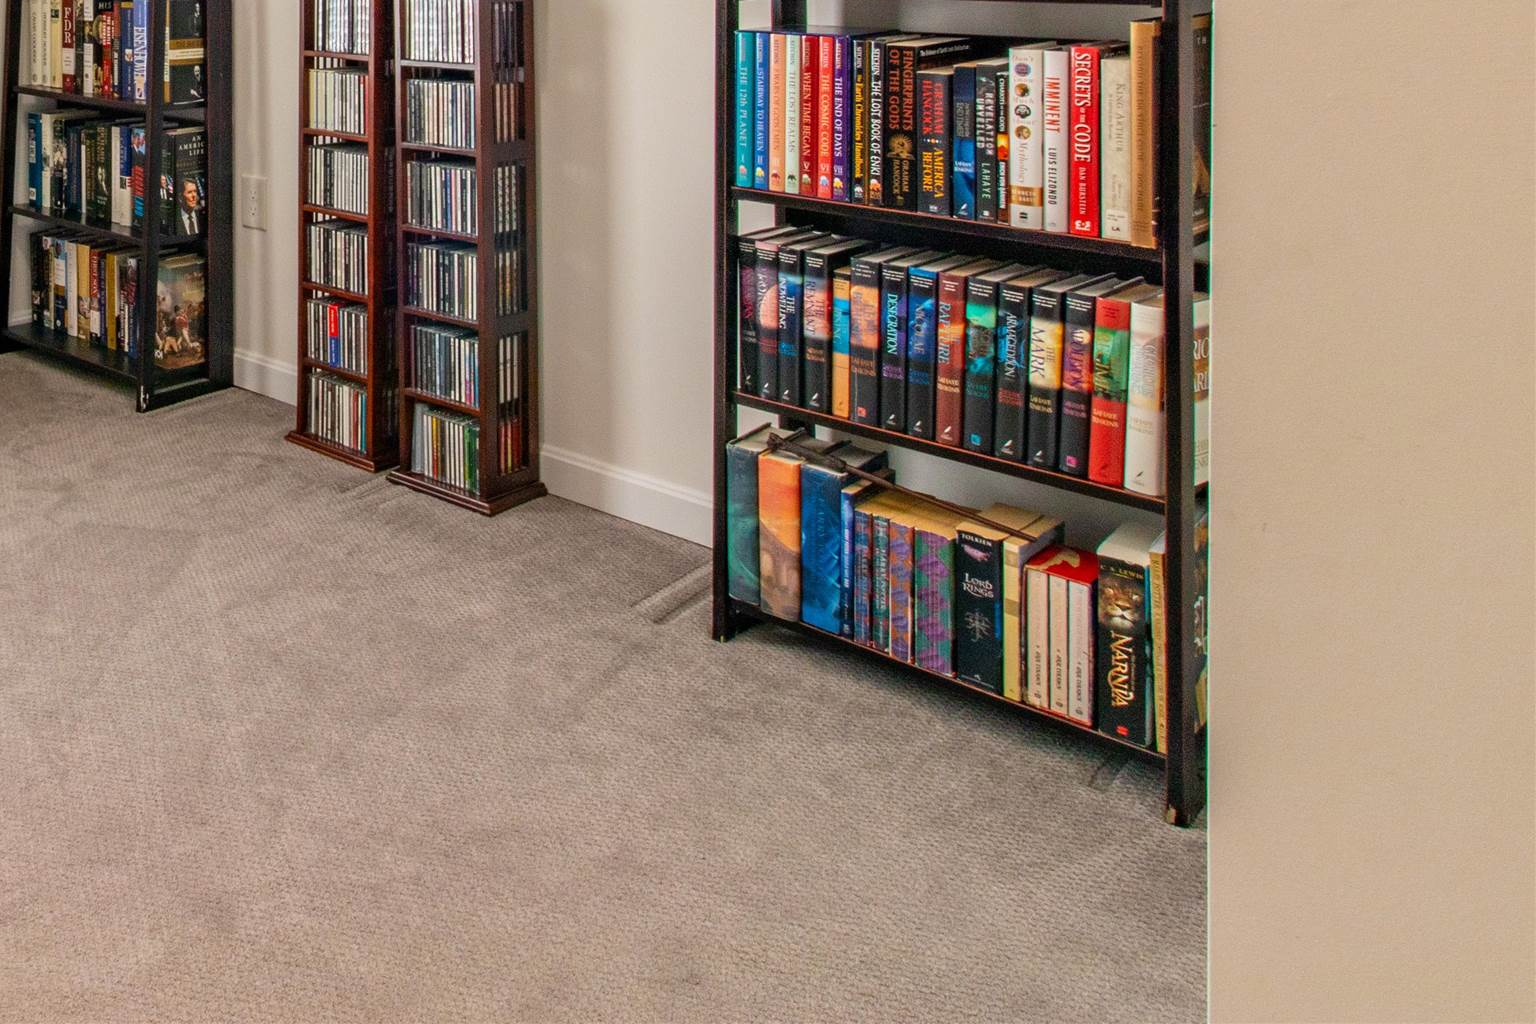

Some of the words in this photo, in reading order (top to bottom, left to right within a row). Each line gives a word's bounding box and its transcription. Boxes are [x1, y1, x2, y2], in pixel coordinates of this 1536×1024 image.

[64, 6, 72, 44] FDR
[134, 26, 146, 84] EISENHOWE
[872, 48, 880, 75] SITCHIN
[889, 49, 900, 68] OF
[740, 66, 748, 85] THE
[803, 72, 811, 100] WHEN
[821, 74, 830, 91] THE
[834, 77, 843, 95] THE
[872, 80, 882, 96] THE
[889, 70, 900, 92] THE
[1074, 52, 1092, 106] SECRETS
[740, 88, 748, 106] 12th
[903, 50, 913, 131] FINGERPRINTS
[1045, 77, 1060, 133] IMMINENT
[1114, 83, 1126, 109] KING
[803, 102, 811, 124] TIME
[821, 94, 830, 127] COSMIC
[834, 98, 843, 120] END
[871, 98, 882, 116] LOST
[888, 96, 900, 130] GODS
[922, 80, 933, 134] HANCOCK
[934, 83, 944, 134] GRAHAM
[740, 109, 748, 147] PLANET
[834, 122, 843, 135] OF
[871, 119, 882, 144] BOOK
[976, 98, 985, 149] UNVEILED
[984, 92, 995, 156] REVELATION
[1114, 113, 1125, 152] ARTHUR
[178, 142, 204, 151] AMERIC
[803, 125, 811, 156] BEGAN
[821, 132, 830, 157] CODE
[834, 136, 843, 157] DAYS
[871, 146, 881, 155] OF
[1074, 124, 1092, 162] CODE
[870, 156, 882, 176] ENKI
[1048, 147, 1056, 165] LUIS
[922, 151, 932, 193] BEFORE
[934, 148, 944, 198] AMERICA
[981, 163, 991, 199] LAHAYE
[1048, 168, 1057, 205] ELIZONDO
[1079, 167, 1087, 180] DAN
[1079, 183, 1087, 215] BURSTEIN
[778, 276, 787, 330] INDWELLING
[786, 295, 795, 314] THE
[804, 279, 815, 336] REMNANT
[815, 299, 825, 318] THE
[887, 293, 898, 355] DESECRATION
[913, 304, 925, 355] NICOLAE
[938, 301, 951, 365] RAPTURE
[1004, 311, 1017, 381] ARMAGEDDON
[1031, 327, 1045, 379] MARK
[1046, 345, 1056, 363] THE
[961, 533, 992, 547] TOLKIEN
[963, 582, 994, 598] RINGS
[965, 573, 992, 589] LORD
[1107, 630, 1135, 708] NARNIA
